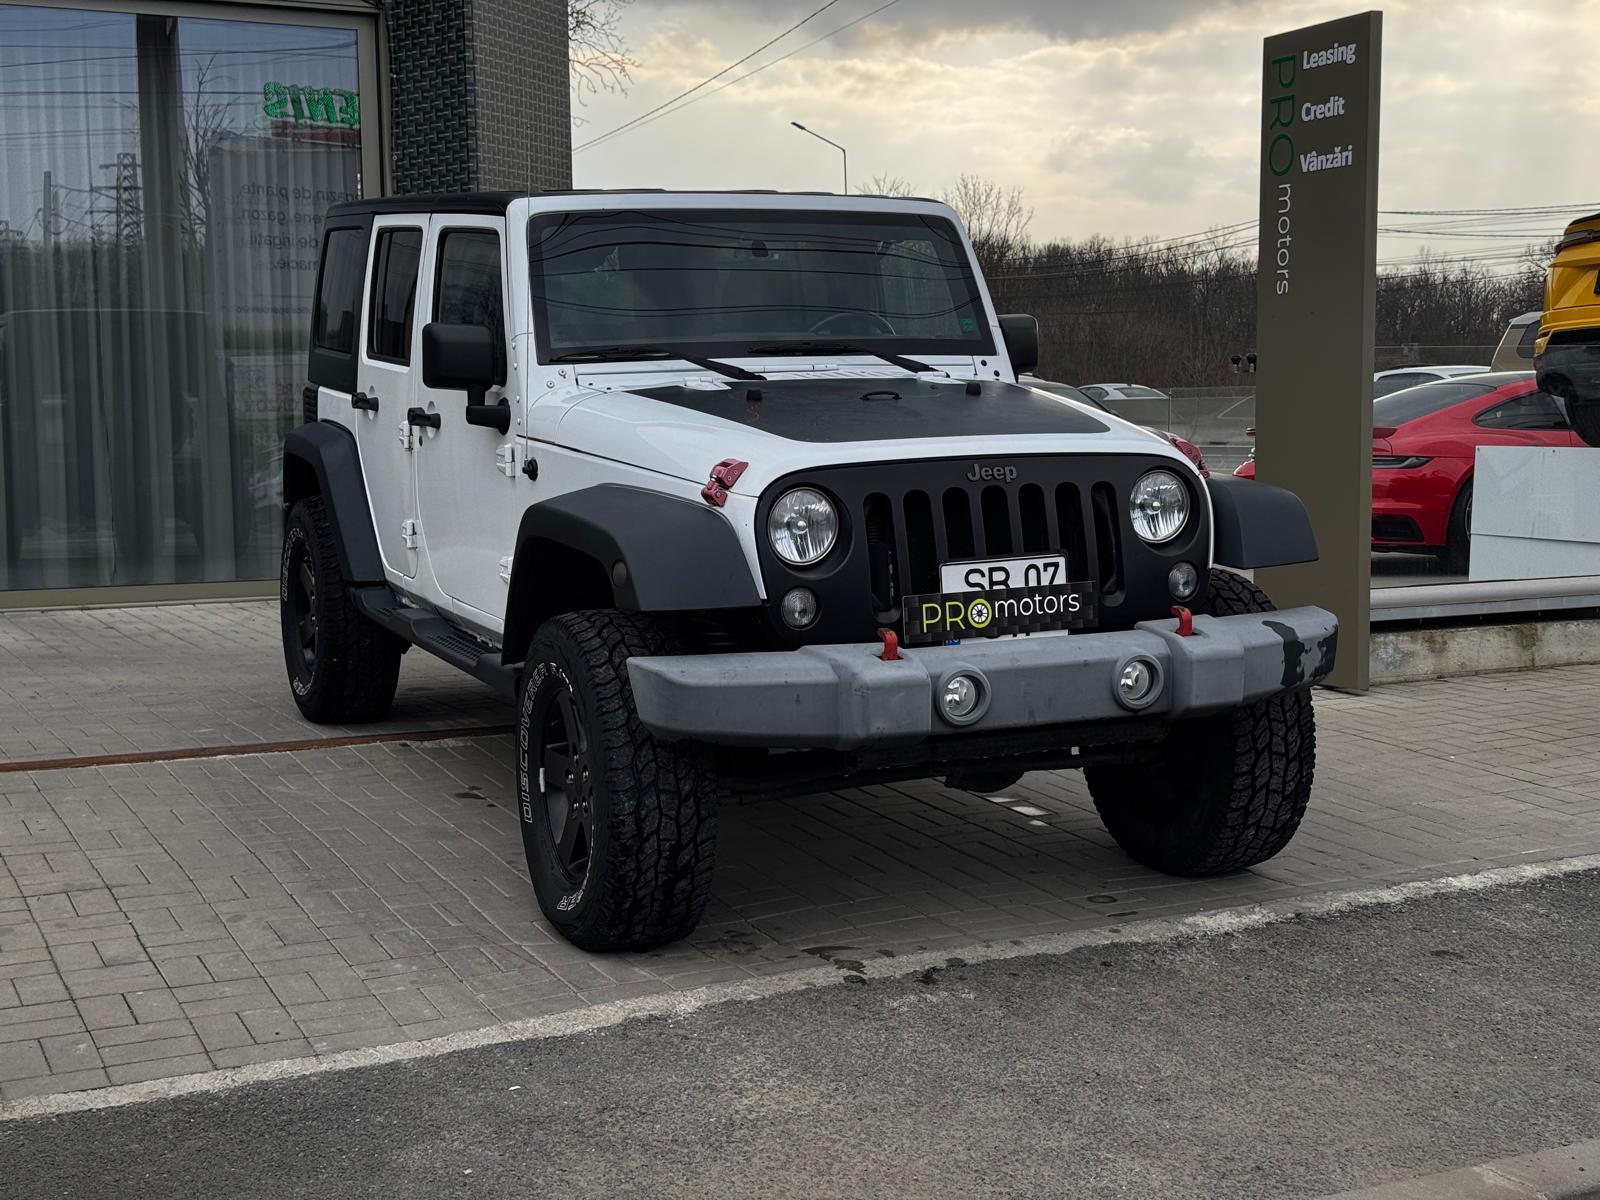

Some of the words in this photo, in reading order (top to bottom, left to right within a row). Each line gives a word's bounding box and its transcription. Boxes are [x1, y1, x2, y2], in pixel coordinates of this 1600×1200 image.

[1303, 42, 1356, 70] Leasing
[1301, 96, 1345, 122] Credit
[1300, 145, 1353, 173] Vânzări
[967, 463, 1017, 482] Jeep
[518, 662, 548, 824] DISCOVERER
